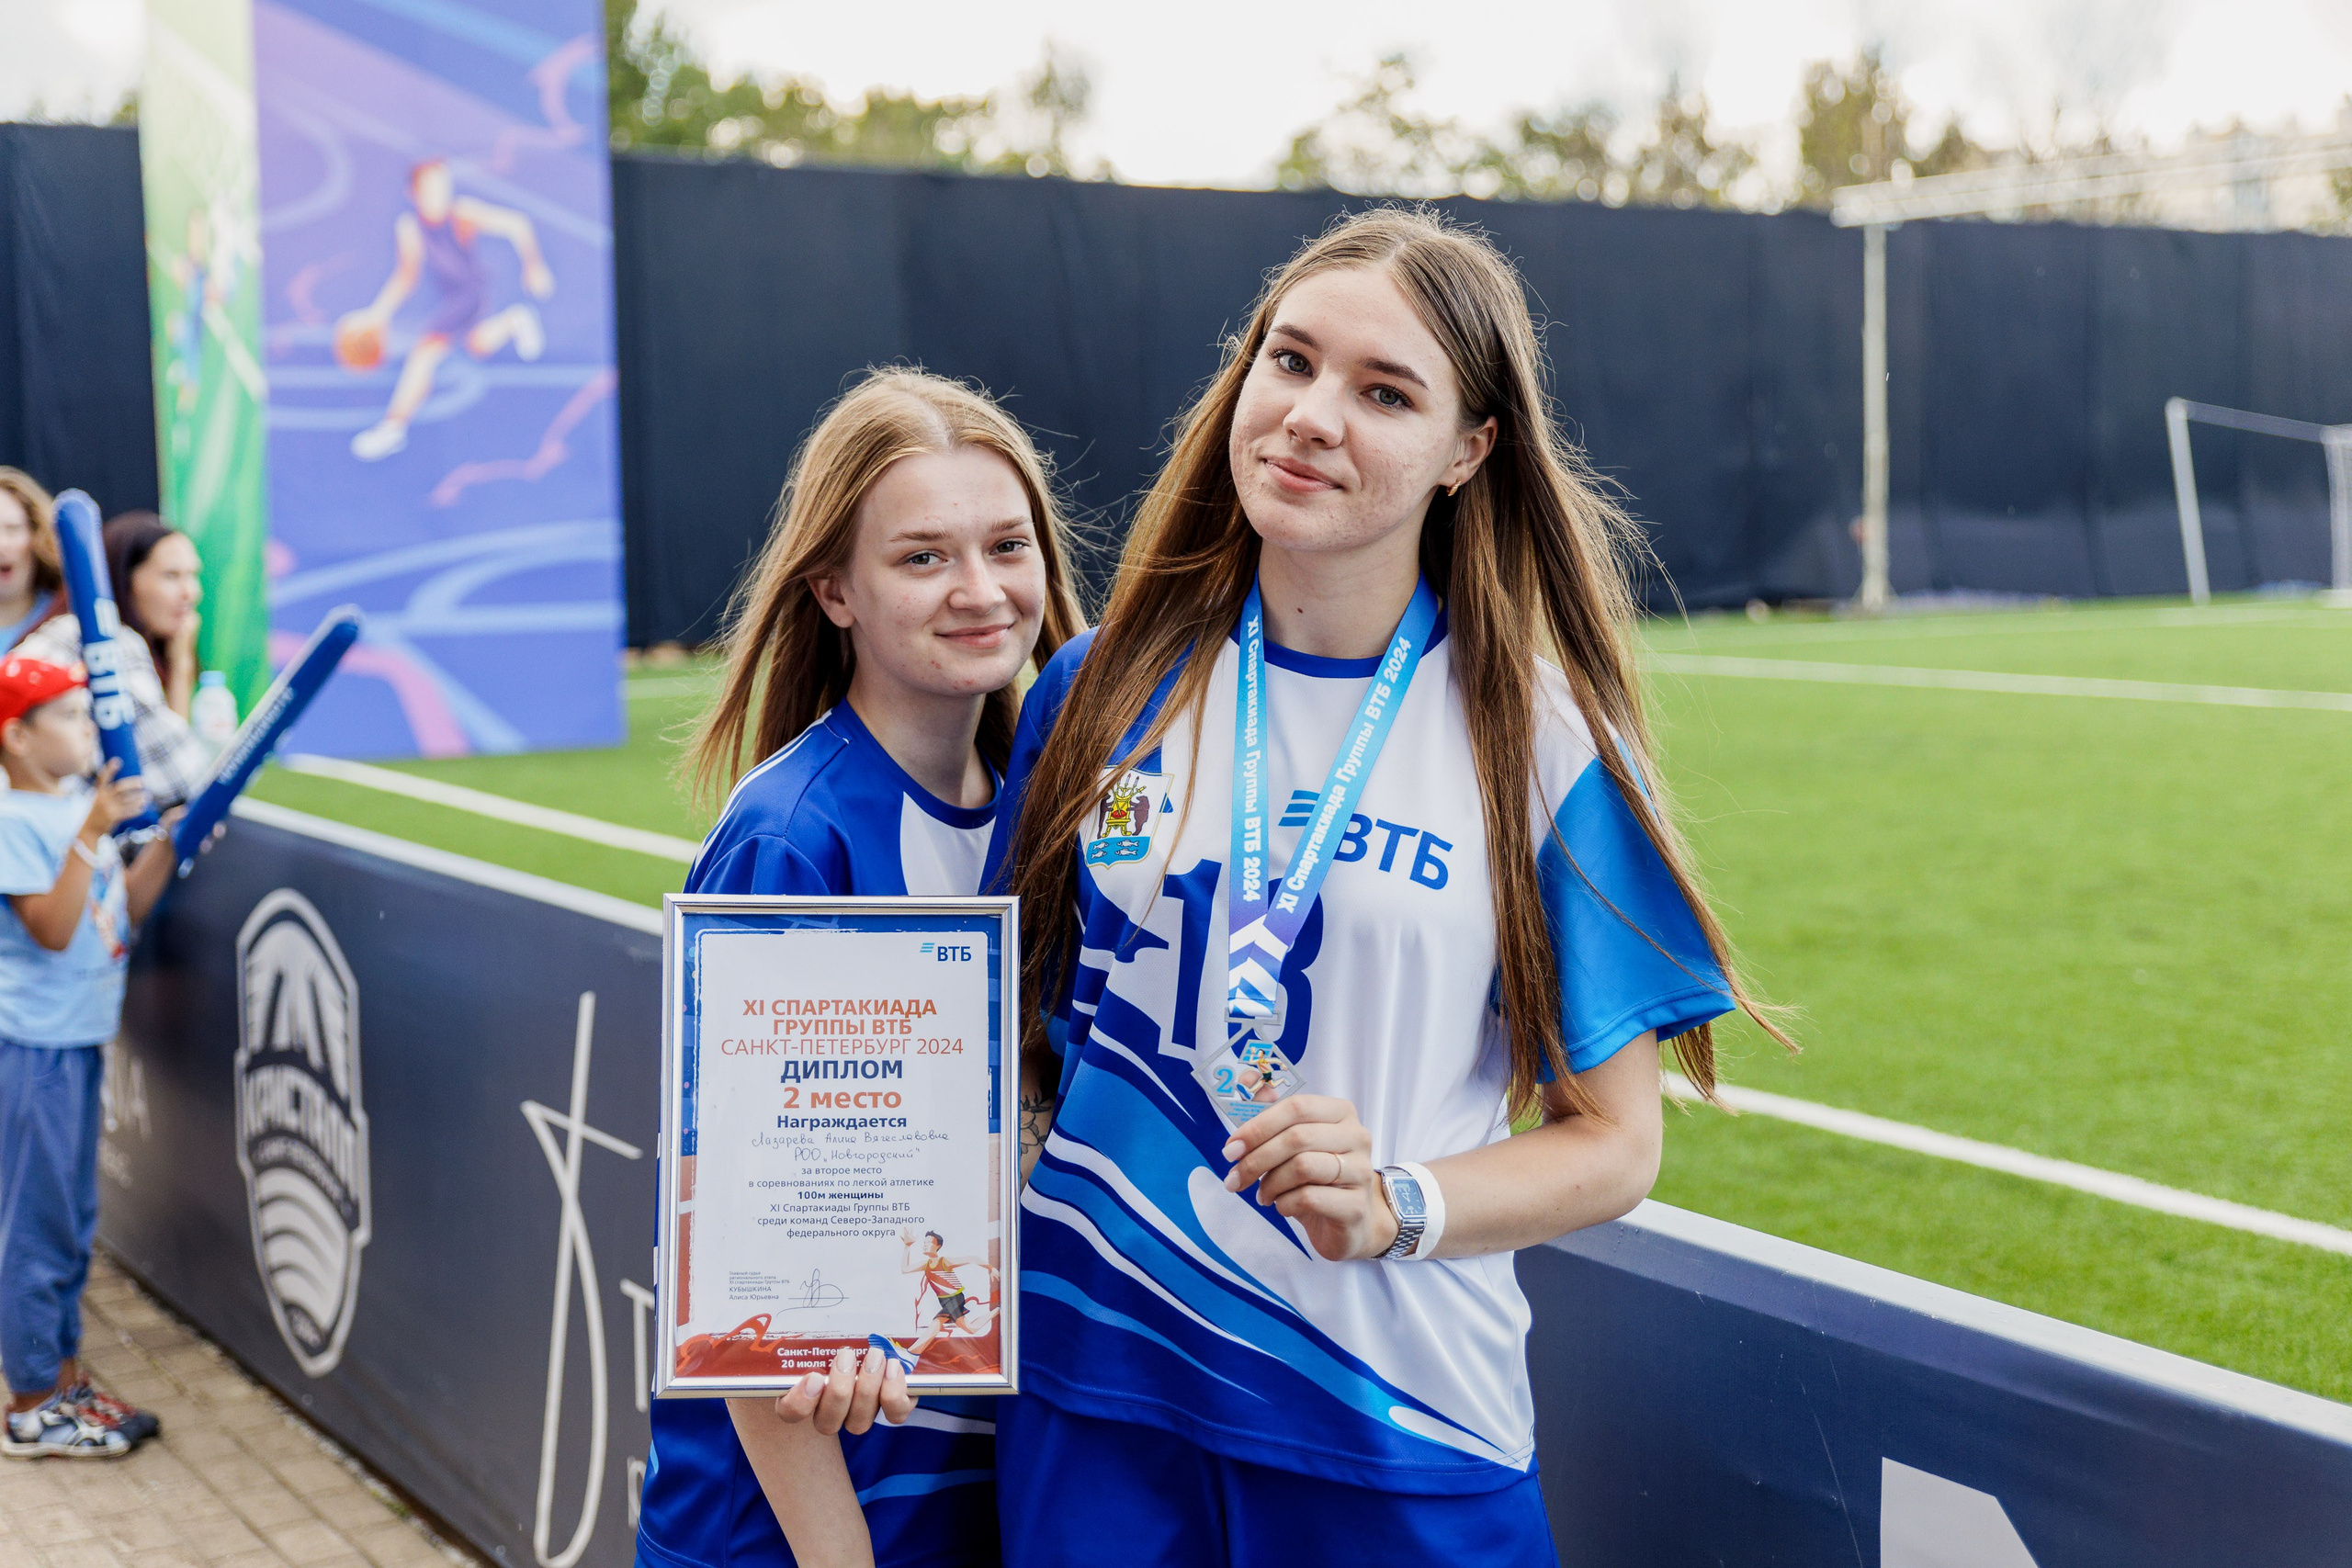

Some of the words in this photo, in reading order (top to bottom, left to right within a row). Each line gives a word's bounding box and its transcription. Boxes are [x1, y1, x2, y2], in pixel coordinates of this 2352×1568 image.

[1248, 615, 1260, 638] XI
[1384, 636, 1412, 683] 2024
[1245, 638, 1260, 748] Спартакиада
[1364, 682, 1391, 721] ВТБ
[1335, 722, 1374, 783] Группы
[1243, 750, 1261, 813] Группы
[1244, 816, 1261, 853] ВТБ
[1286, 784, 1347, 891] Спартакиада
[1332, 813, 1453, 890] ВТБ
[1243, 856, 1261, 902] 2024
[1276, 892, 1299, 915] XI
[937, 946, 972, 962] ВТБ
[742, 999, 764, 1016] XI
[771, 999, 937, 1019] СПАРТАКИАДА
[774, 1020, 865, 1035] ГРУППЫ
[873, 1019, 912, 1035] ВТБ
[721, 1039, 911, 1055] САНКТ-ПЕТЕРБУРГ
[916, 1038, 964, 1055] 2024
[781, 1060, 902, 1084] ДИПЛОМ
[1216, 1067, 1234, 1094] 2
[783, 1087, 799, 1109] 2
[810, 1090, 902, 1109] место
[777, 1115, 907, 1132] Награждается
[752, 1132, 815, 1149] Лазарева
[825, 1132, 857, 1145] Алина
[794, 1147, 821, 1161] РОО
[815, 1168, 850, 1177] второе
[757, 1179, 834, 1190] соревнованиях
[853, 1177, 887, 1187] легкой
[889, 1179, 934, 1187] атлетике
[797, 1191, 825, 1200] 100м
[828, 1190, 884, 1201] женщины
[770, 1204, 780, 1213] XI
[783, 1203, 851, 1214] Спартакиады
[854, 1203, 889, 1213] Группы
[892, 1202, 910, 1211] ВТБ
[757, 1217, 787, 1227] среди
[790, 1217, 828, 1226] команд
[831, 1215, 925, 1226] Северо-Западного
[786, 1228, 859, 1239] федерального
[862, 1229, 896, 1238] округа
[776, 1346, 868, 1358] Санкт-Петерг
[781, 1359, 795, 1368] 20
[797, 1360, 826, 1369] июля
